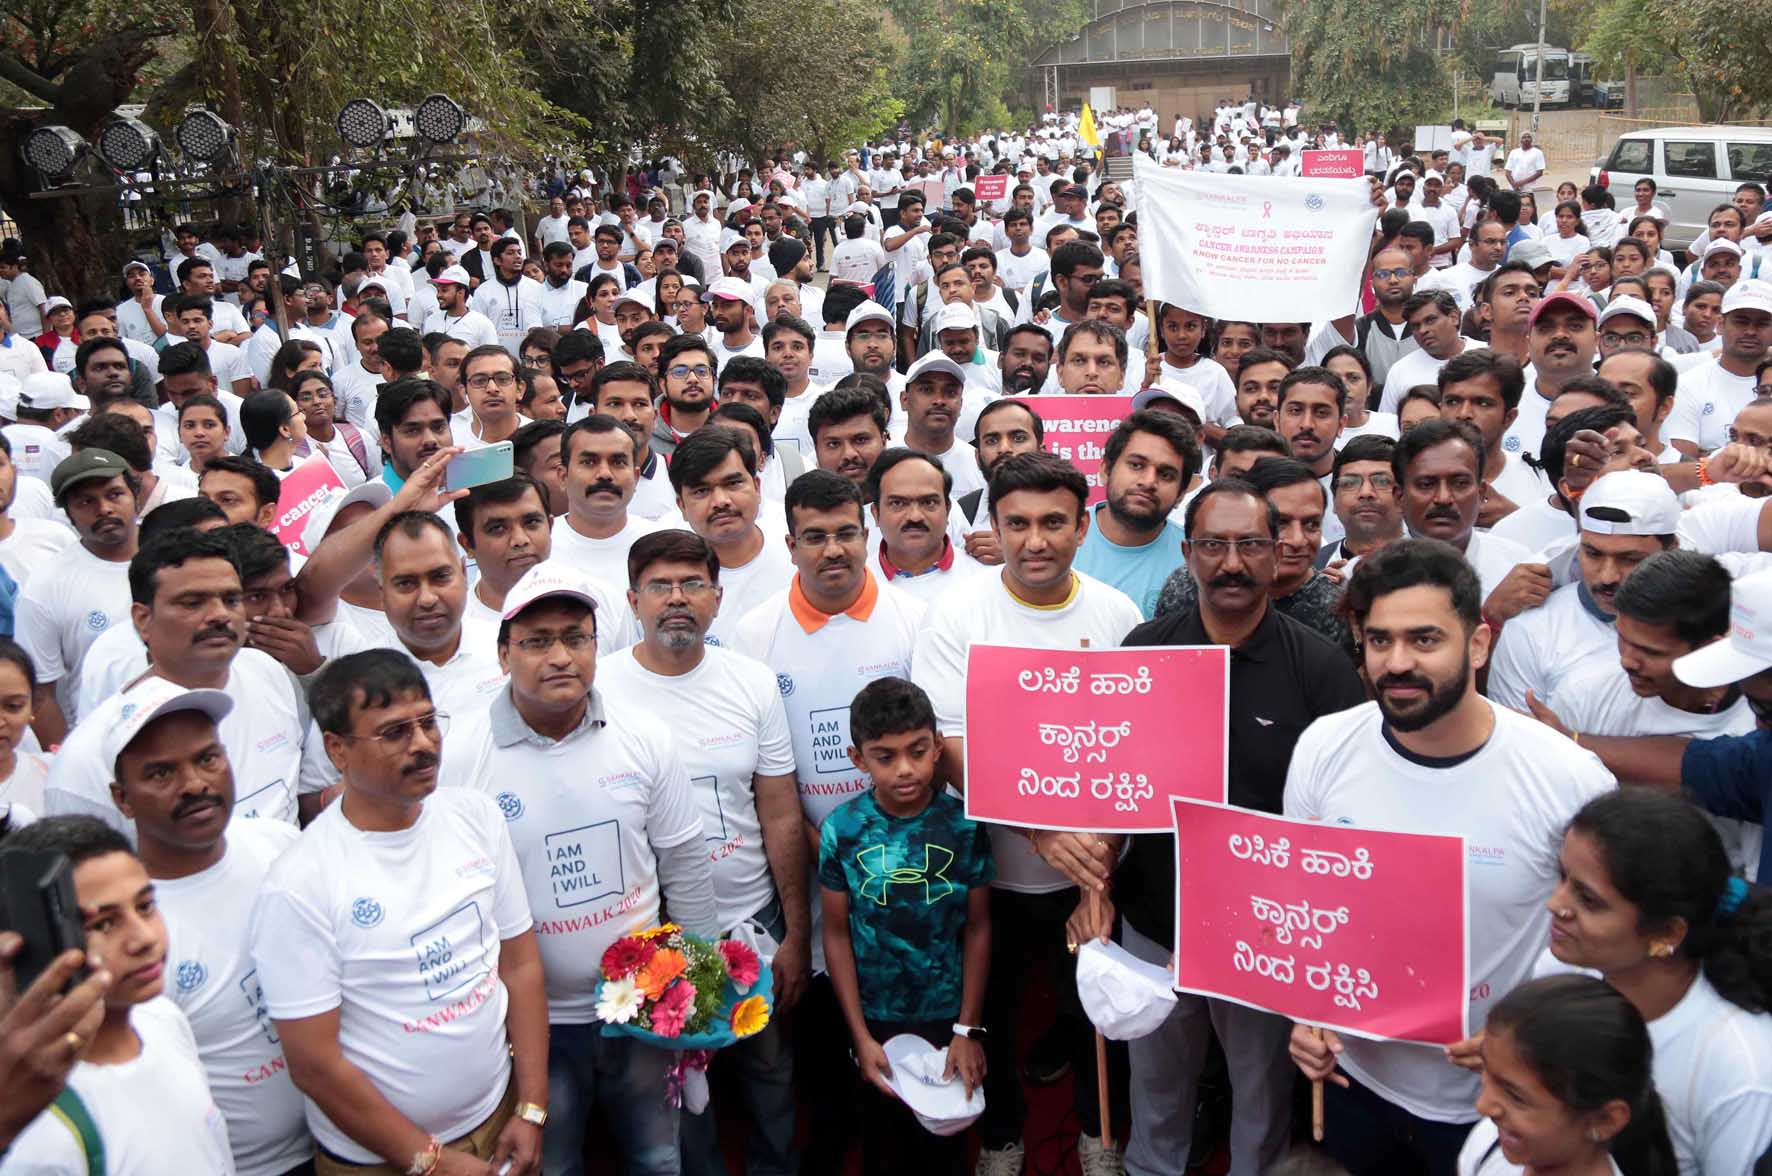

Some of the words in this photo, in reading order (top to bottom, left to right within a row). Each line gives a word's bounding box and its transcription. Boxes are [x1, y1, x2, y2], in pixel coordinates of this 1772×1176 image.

[1199, 240, 1232, 251] CANCER
[1193, 249, 1218, 260] KNOW
[1221, 254, 1255, 264] CANCER
[1291, 257, 1327, 265] CANCER
[1042, 418, 1122, 433] warene
[1052, 441, 1072, 460] is
[280, 484, 328, 526] cancer
[1018, 666, 1081, 694] ಲಸಿಕೆ
[1090, 665, 1153, 695] ಹಾಕಿ
[818, 721, 839, 733] AM
[813, 735, 841, 748] AND
[1039, 720, 1131, 763] ಕ್ಯಾನ್ಸರ್
[1018, 768, 1081, 798] ನಿಂದ
[1091, 772, 1154, 812] ರಕ್ಷಿಸಿ
[547, 849, 552, 862] I
[556, 843, 583, 860] AM
[1228, 833, 1291, 868] ಲಸಿಕೆ
[1301, 848, 1374, 880] ಹಾಕಿ
[551, 860, 586, 878] AND
[562, 873, 602, 892] WILL
[617, 886, 642, 914] 2020
[1250, 895, 1349, 950] ಕ್ಯಾನ್ಸರ್
[420, 951, 452, 975] AND
[1233, 940, 1295, 984] ನಿಂದ
[1306, 962, 1378, 1011] ರಕ್ಷಿಸಿ
